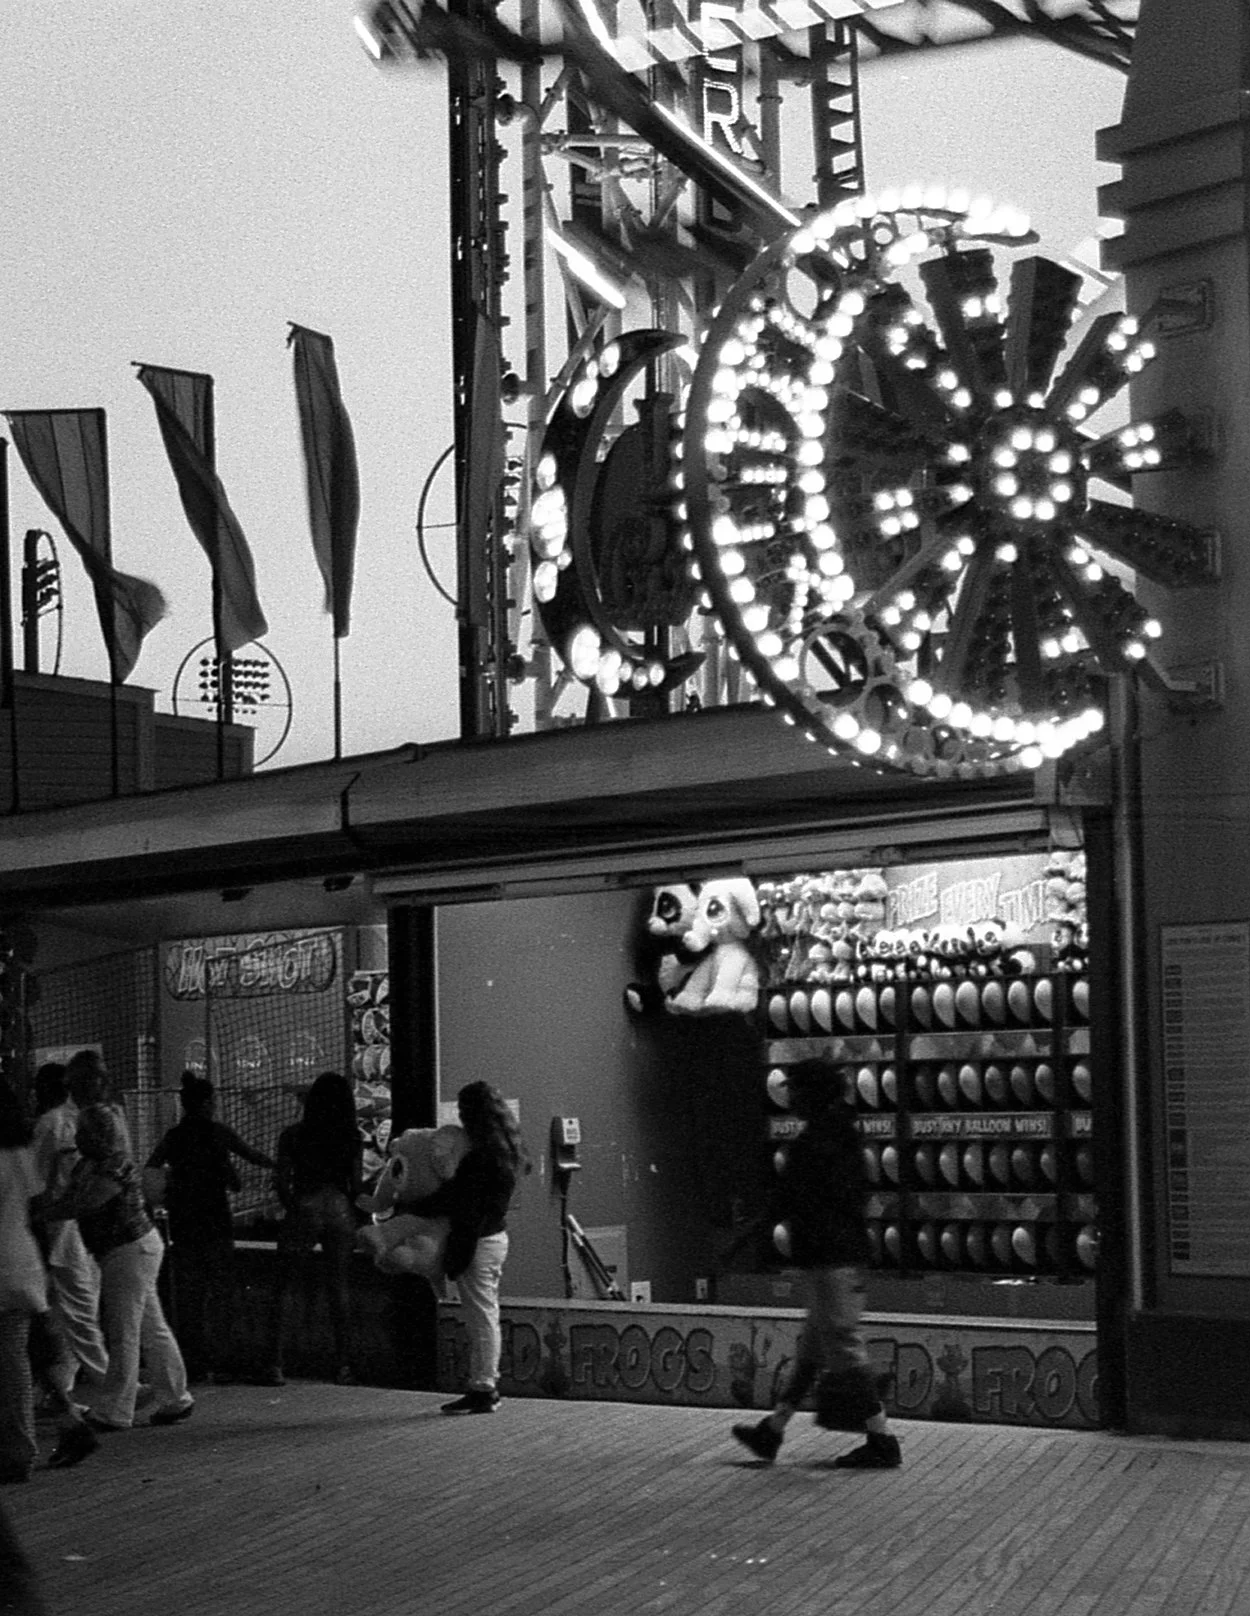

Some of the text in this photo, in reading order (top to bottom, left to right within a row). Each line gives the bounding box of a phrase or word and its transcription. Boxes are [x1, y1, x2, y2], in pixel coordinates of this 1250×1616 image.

[887, 871, 1047, 933] PRIZE EVERY TIM
[240, 938, 318, 988] SHOT
[965, 1118, 1011, 1133] BALLOON
[570, 1323, 715, 1392] FROGS
